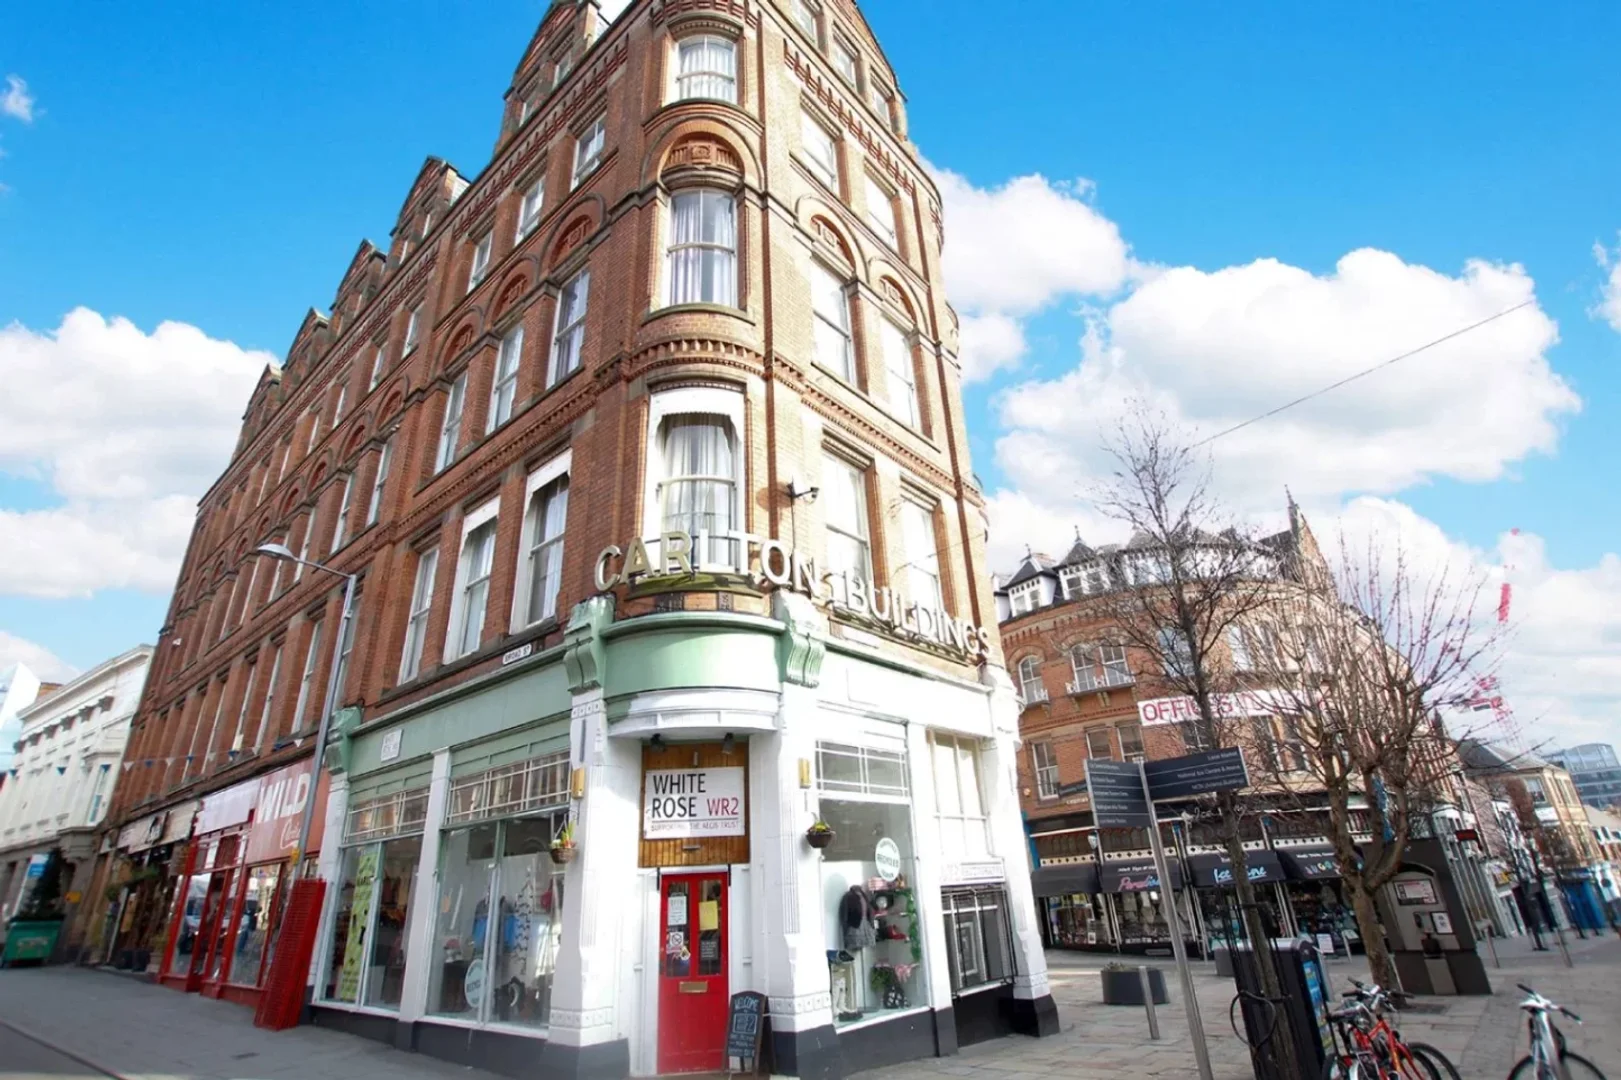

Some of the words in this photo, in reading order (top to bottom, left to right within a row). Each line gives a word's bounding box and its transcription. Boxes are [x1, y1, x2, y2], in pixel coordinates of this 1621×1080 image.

[594, 528, 821, 598] CARLTON
[843, 569, 992, 658] BUILDINGS
[1143, 695, 1233, 721] OFFICS
[653, 772, 706, 795] WHITE
[256, 772, 312, 825] WILD
[651, 796, 698, 818] ROSE
[706, 796, 739, 817] WR2
